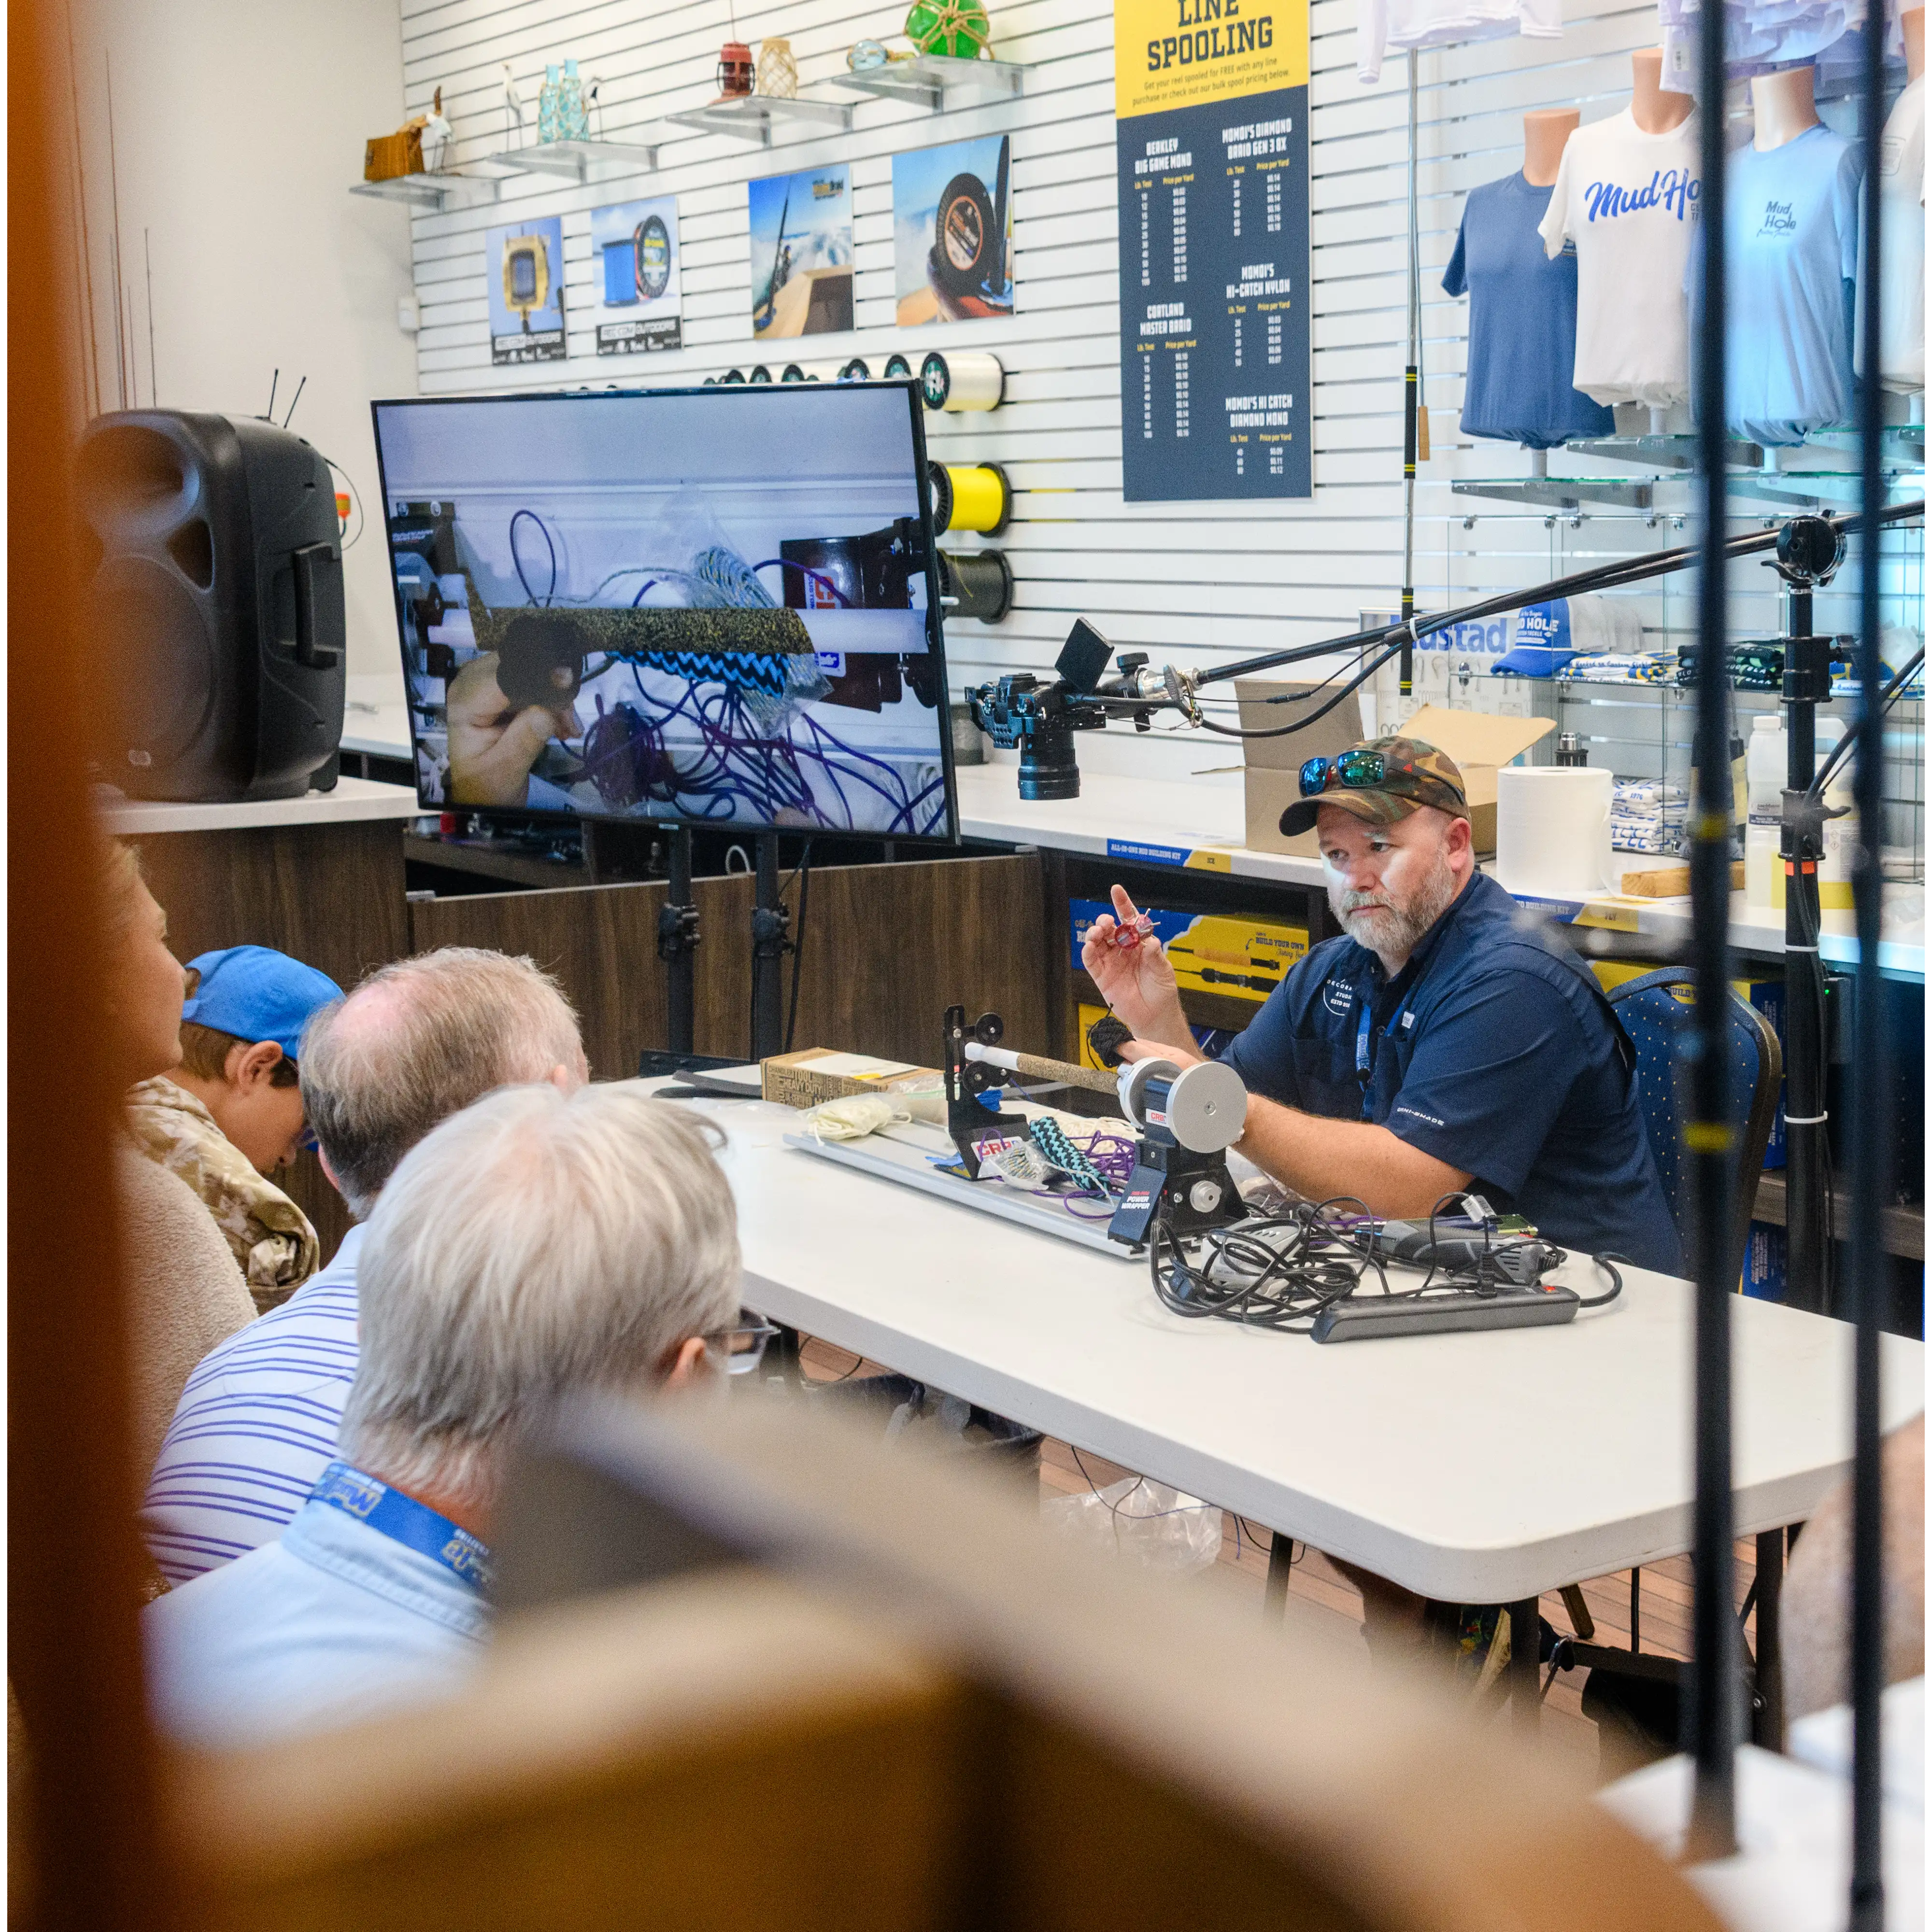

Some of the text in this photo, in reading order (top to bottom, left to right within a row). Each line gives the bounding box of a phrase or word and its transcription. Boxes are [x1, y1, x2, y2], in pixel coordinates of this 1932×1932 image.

[1178, 0, 1239, 27] LINE
[1148, 16, 1272, 71] SPOOLING
[1144, 81, 1155, 90] Get
[1156, 79, 1169, 90] your
[1171, 74, 1183, 85] reel
[1209, 69, 1218, 78] for
[1220, 65, 1235, 75] FREE
[1236, 61, 1250, 72] with
[1252, 61, 1263, 71] any
[1265, 57, 1277, 67] line
[1132, 92, 1160, 107] purchase
[1162, 92, 1167, 100] or
[1169, 87, 1186, 99] check
[1188, 86, 1198, 95] out
[1212, 79, 1225, 90] bulk
[1227, 77, 1244, 89] spool
[1246, 72, 1268, 85] pricing
[1222, 118, 1292, 143] MOMOI'S DIAMOND
[1146, 138, 1179, 156] BERKLEY
[1228, 142, 1251, 159] BRAID
[1253, 139, 1268, 156] GEN
[1269, 138, 1275, 153] 3
[1135, 152, 1192, 174] BIG GAME MONO
[1584, 168, 1701, 222] Mud Ho
[1765, 201, 1792, 214] Mud
[1764, 211, 1797, 229] Hole
[1241, 263, 1275, 280] MOMOI'S
[1226, 279, 1290, 299] HI-CATCH NYLON
[1147, 302, 1184, 319] CORTLAND
[1140, 318, 1191, 336] MASTER BRAID
[1225, 394, 1293, 411] MOMOI'S HI CATCH
[1230, 412, 1288, 427] DIAMOND MONO
[1526, 618, 1560, 633] HOLE
[1526, 902, 1570, 914] BUILDING KIT
[1256, 937, 1304, 950] BUILD YOUR OWN
[783, 1080, 805, 1092] HEAVY
[805, 1082, 821, 1094] DUTY
[1151, 1113, 1164, 1122] CRB
